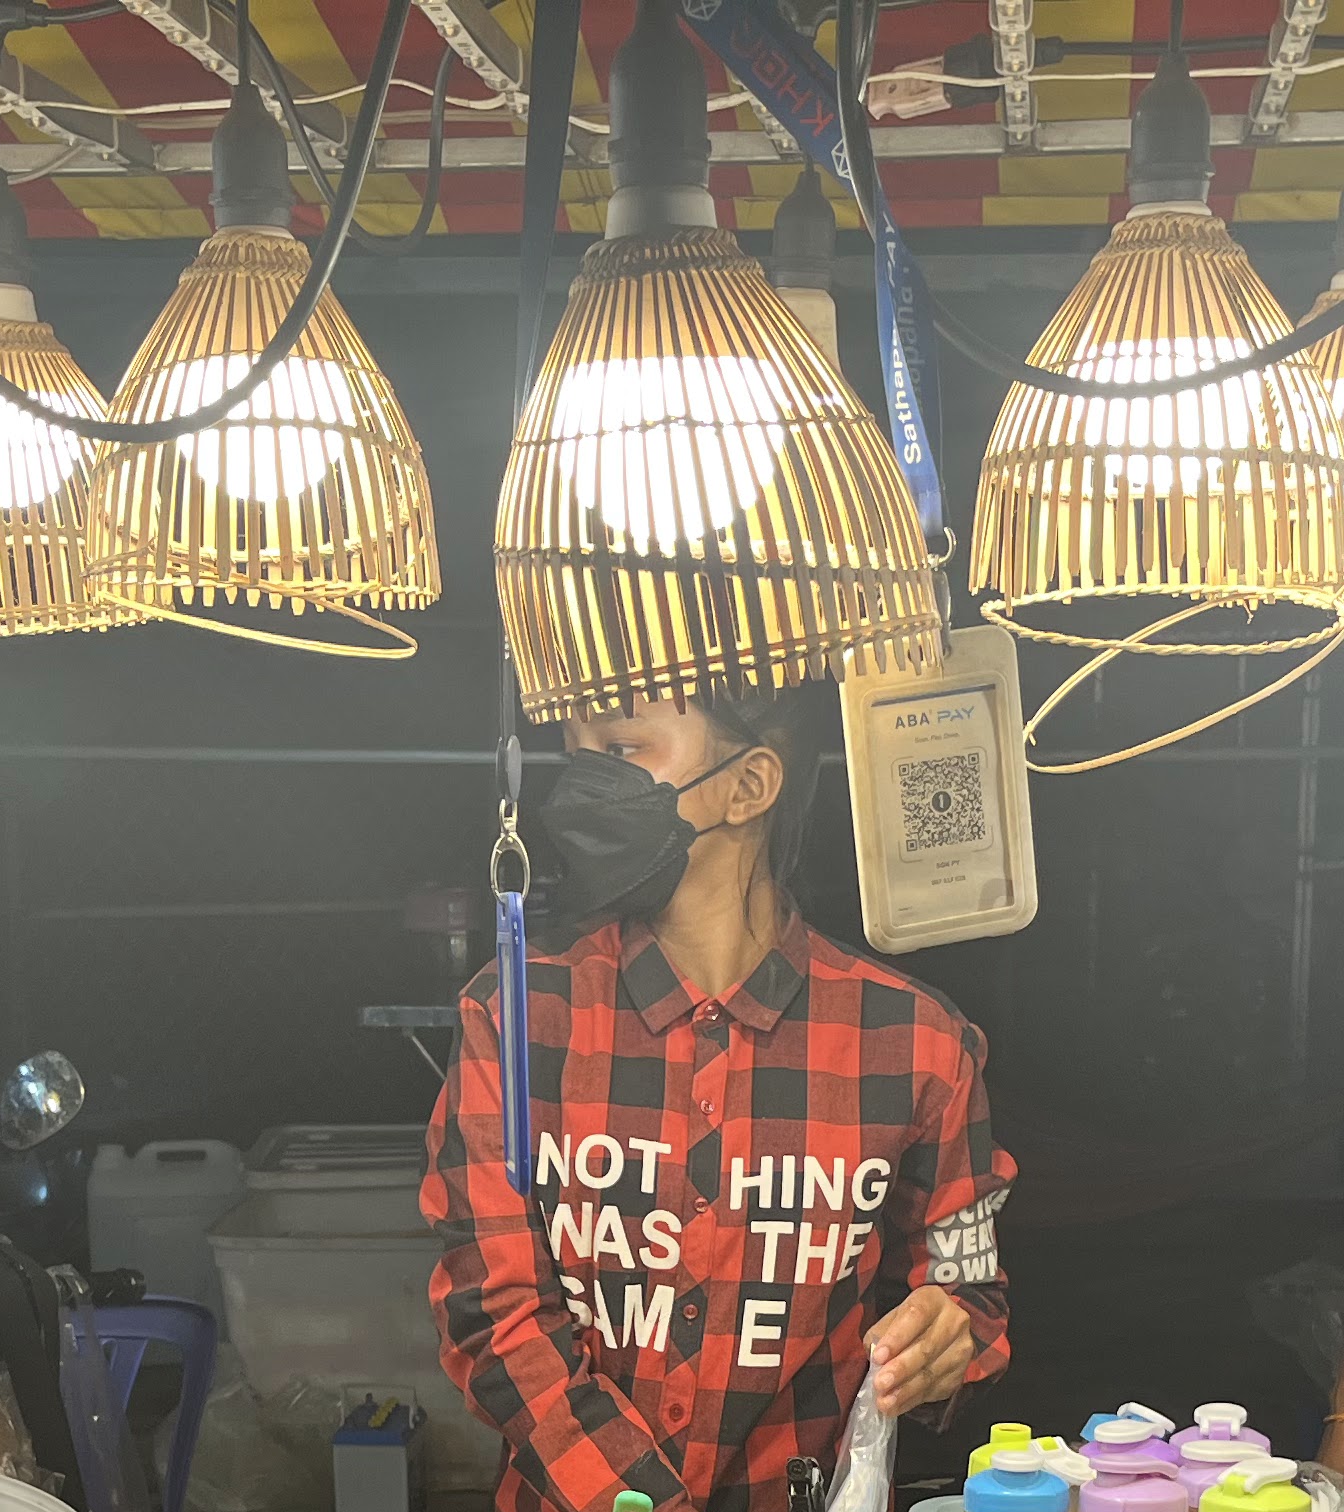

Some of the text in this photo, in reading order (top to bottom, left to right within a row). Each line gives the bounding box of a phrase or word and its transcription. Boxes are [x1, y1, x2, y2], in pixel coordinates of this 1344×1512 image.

[894, 705, 976, 730] ABA PAY
[536, 1131, 671, 1194] NOT
[729, 1155, 891, 1211] HING
[540, 1201, 872, 1285] WAS THE
[737, 1299, 786, 1368] E
